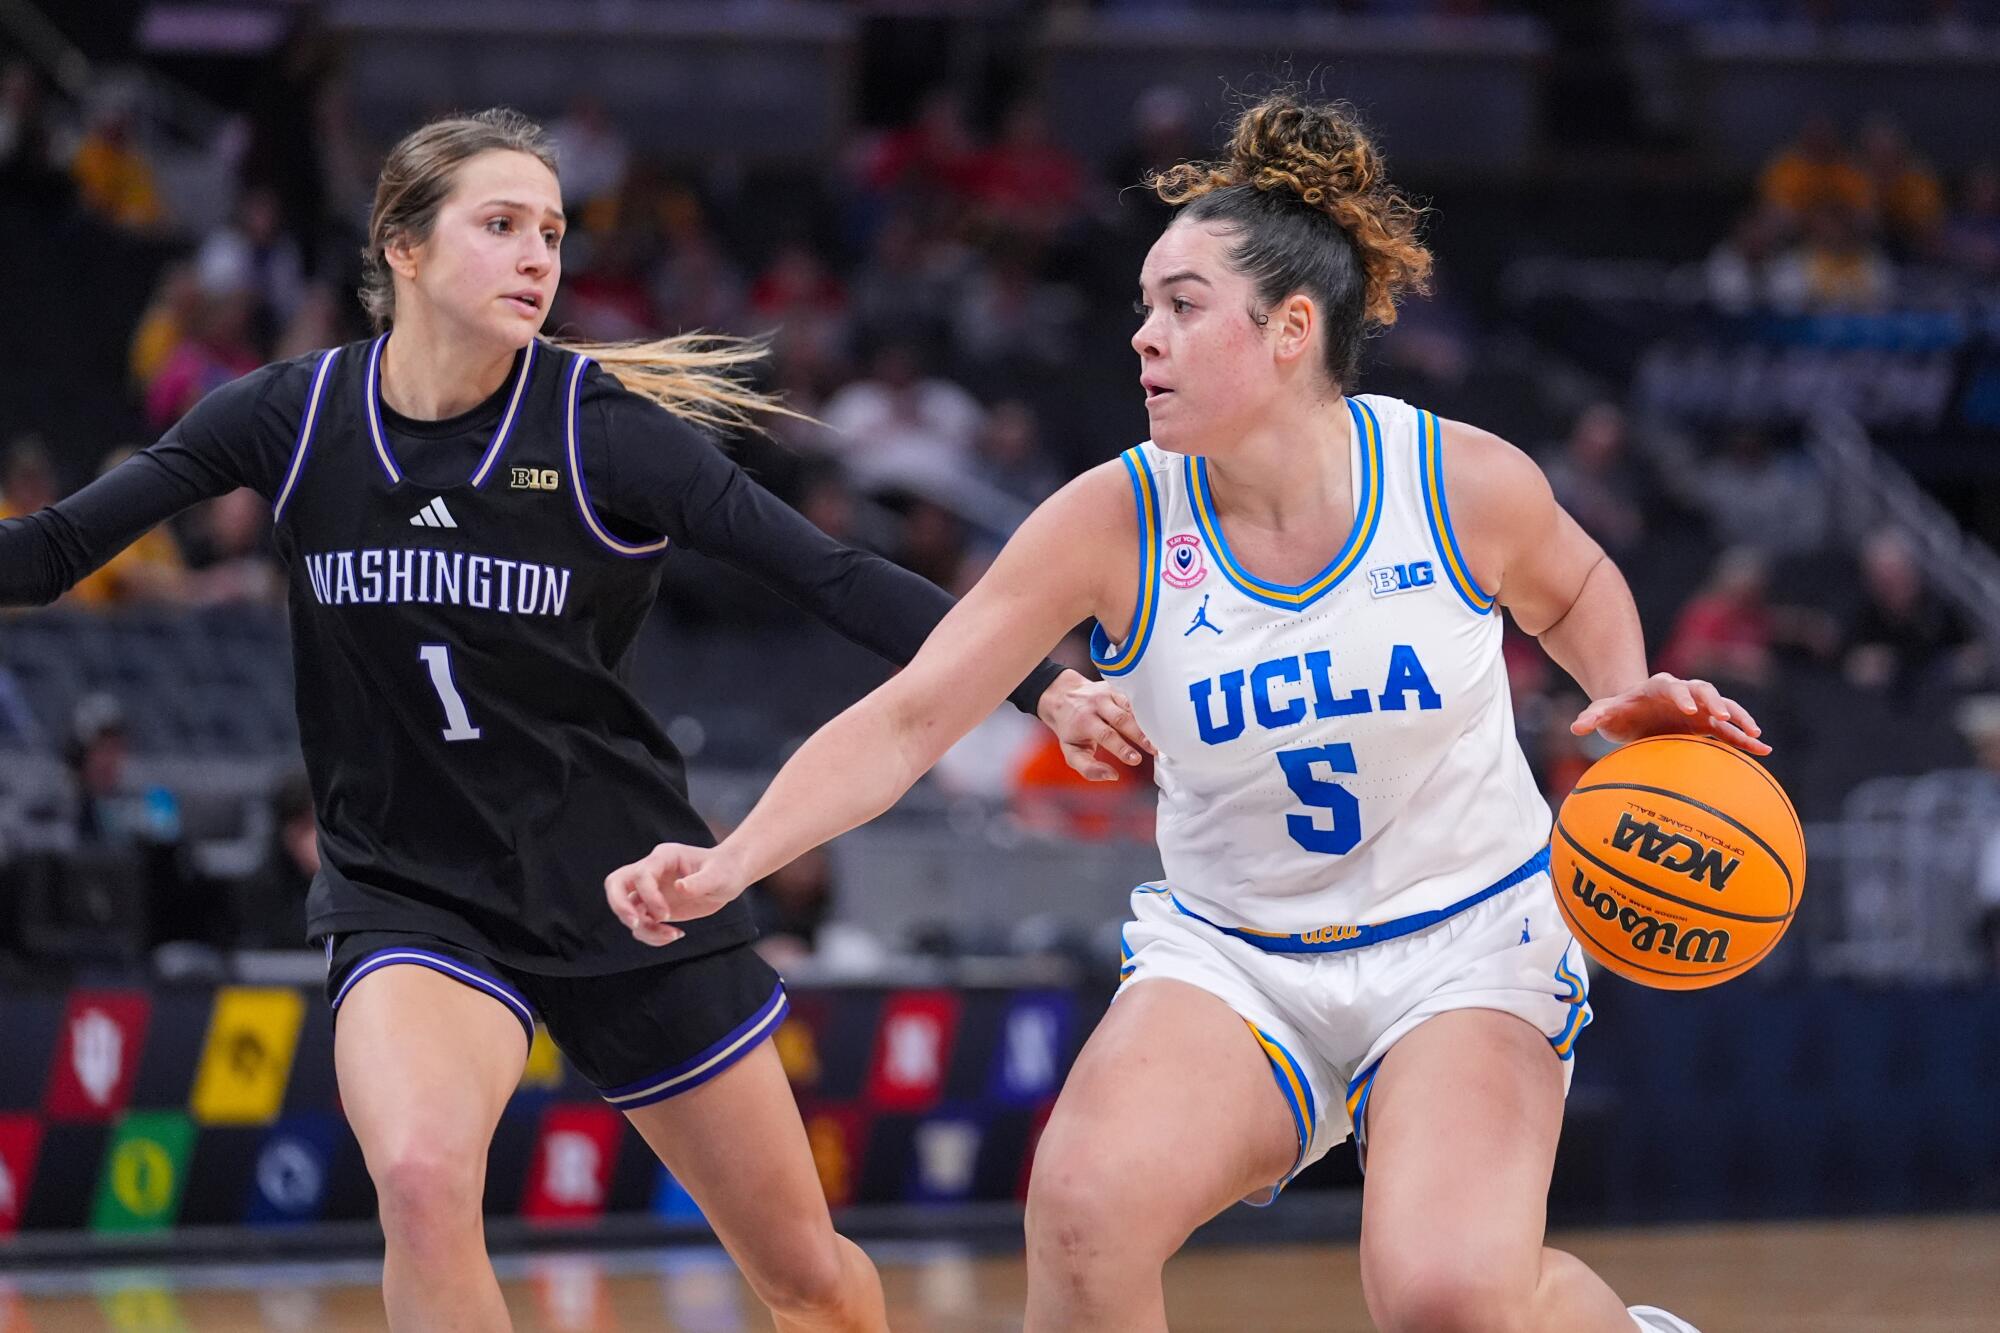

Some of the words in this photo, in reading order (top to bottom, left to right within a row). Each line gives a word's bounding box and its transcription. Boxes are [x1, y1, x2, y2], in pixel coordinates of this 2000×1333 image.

[304, 548, 571, 616] WASHINGTON
[418, 643, 481, 742] 1
[1189, 645, 1442, 745] UCLA
[1276, 743, 1362, 855] 5
[1626, 801, 1656, 818] BALL
[1657, 814, 1693, 833] GAME
[1611, 811, 1741, 892] NCAA
[1695, 828, 1745, 857] OFFICIAL
[1571, 865, 1731, 964] Wilson
